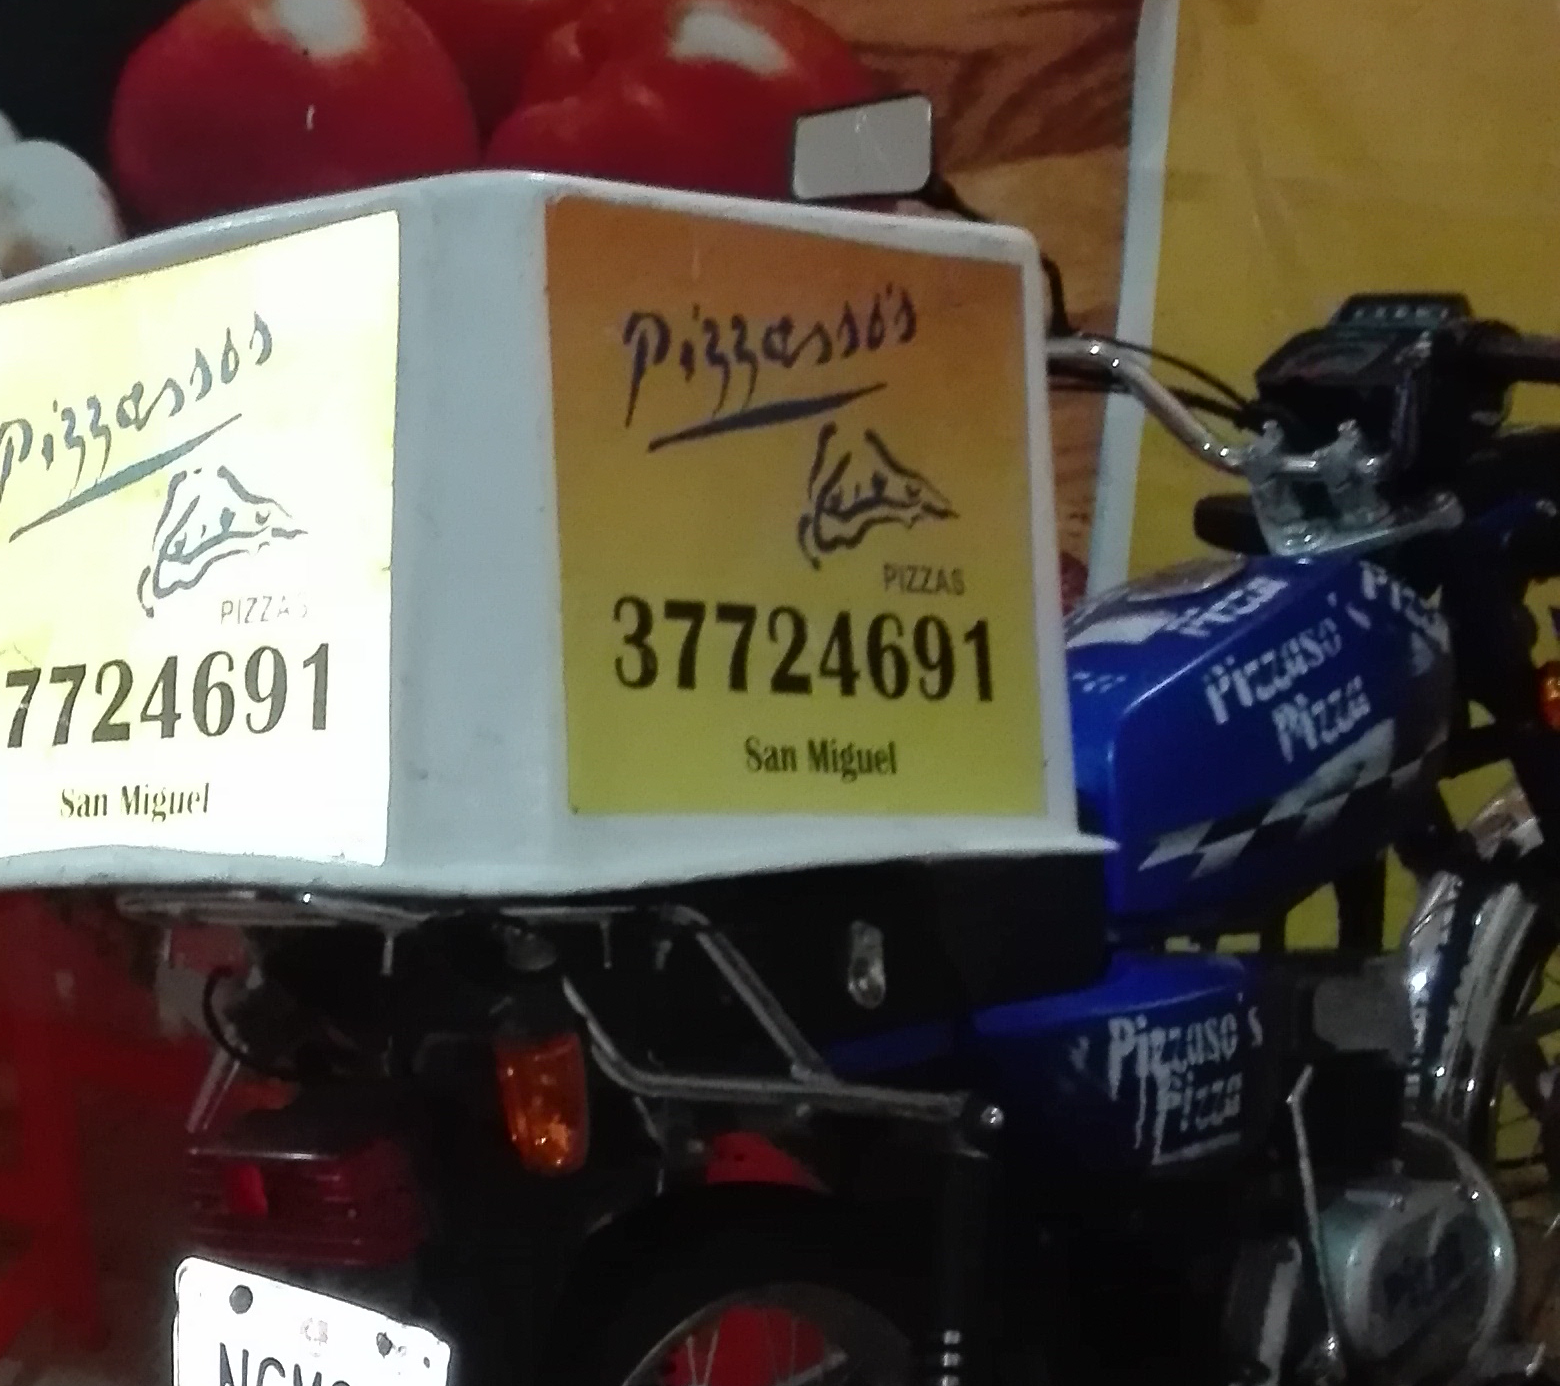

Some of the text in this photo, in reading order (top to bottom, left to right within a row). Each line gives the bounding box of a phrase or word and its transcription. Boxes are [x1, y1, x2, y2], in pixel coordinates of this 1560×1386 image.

[883, 562, 966, 597] PIZZAS
[613, 594, 994, 702] 37724691
[1271, 675, 1372, 764] Pizza
[745, 735, 898, 783] San Miguel
[59, 782, 210, 823] San Miguel
